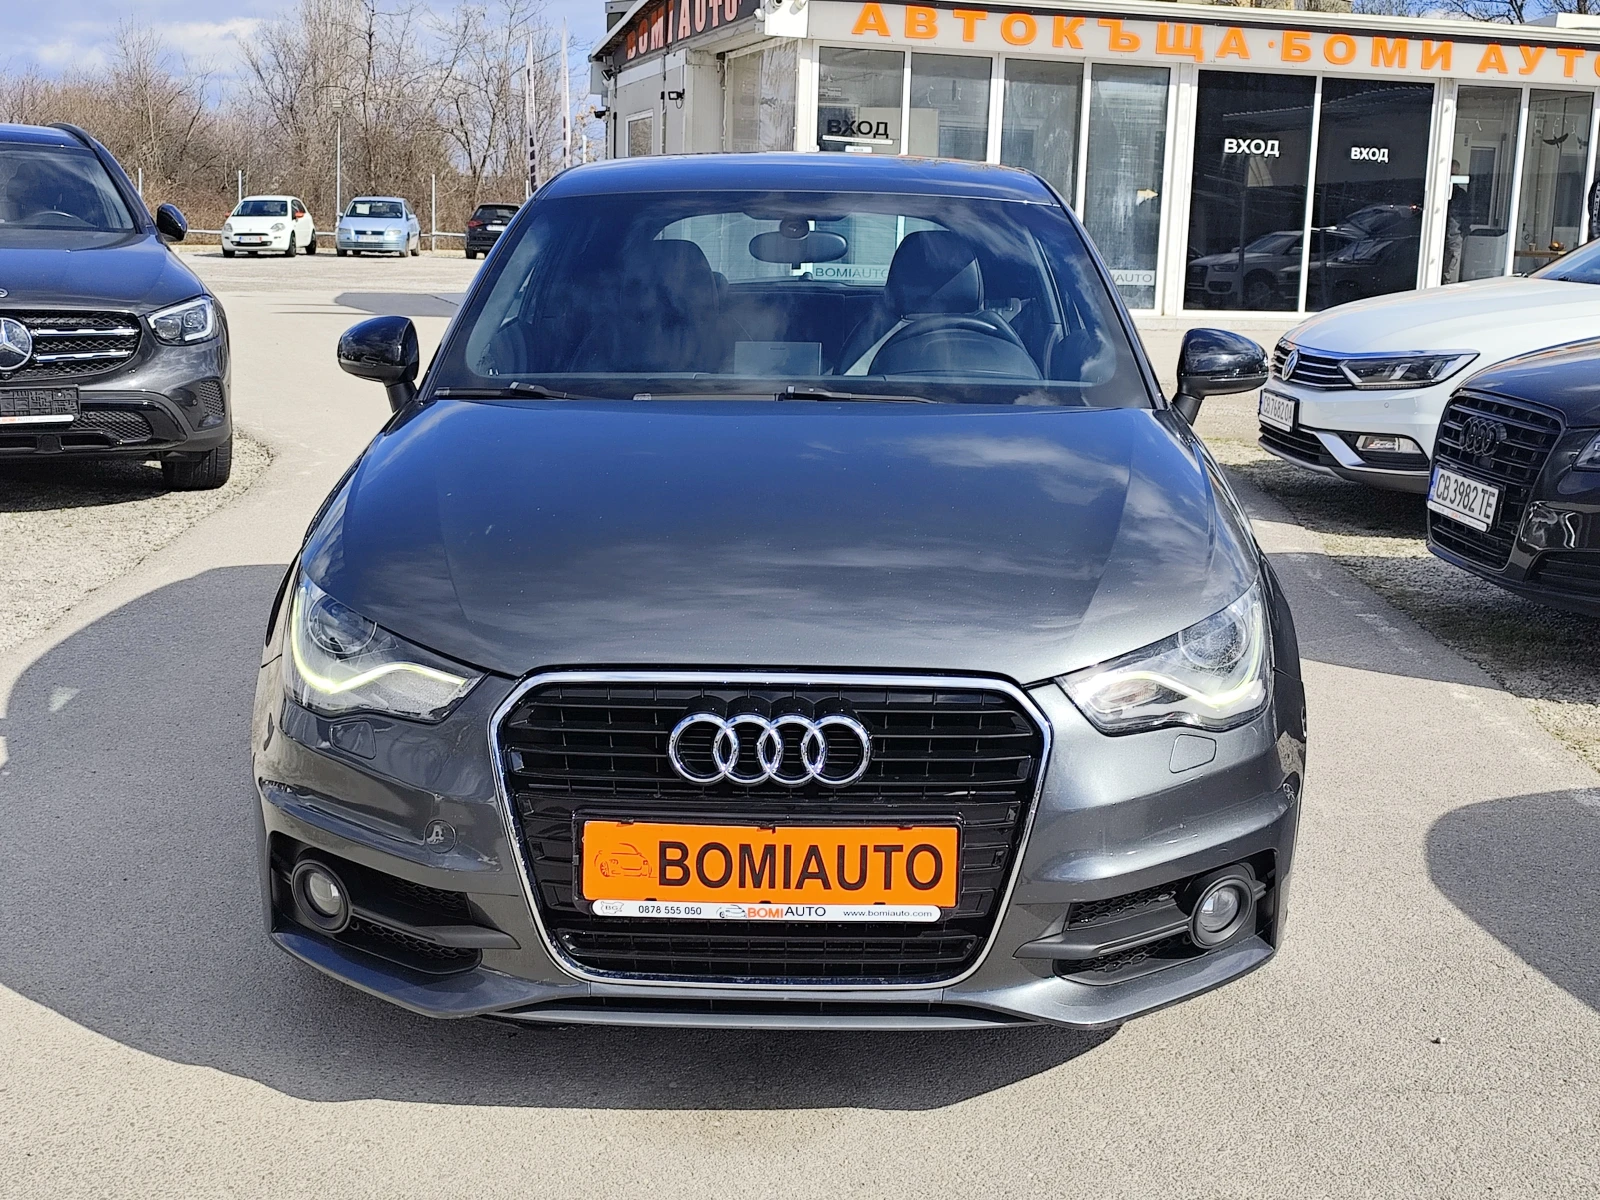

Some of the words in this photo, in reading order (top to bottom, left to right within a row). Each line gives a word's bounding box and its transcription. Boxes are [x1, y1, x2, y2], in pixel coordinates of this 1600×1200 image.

[1476, 43, 1600, 78] АУТ
[826, 120, 890, 139] ВХОД
[1224, 138, 1280, 158] ВХОД
[1350, 147, 1389, 163] ВХОД
[658, 840, 943, 890] BOMIAUTO
[638, 905, 661, 914] 0878
[664, 906, 682, 915] 555
[684, 906, 702, 915] 050
[843, 910, 932, 918] www.bomiauto.com
